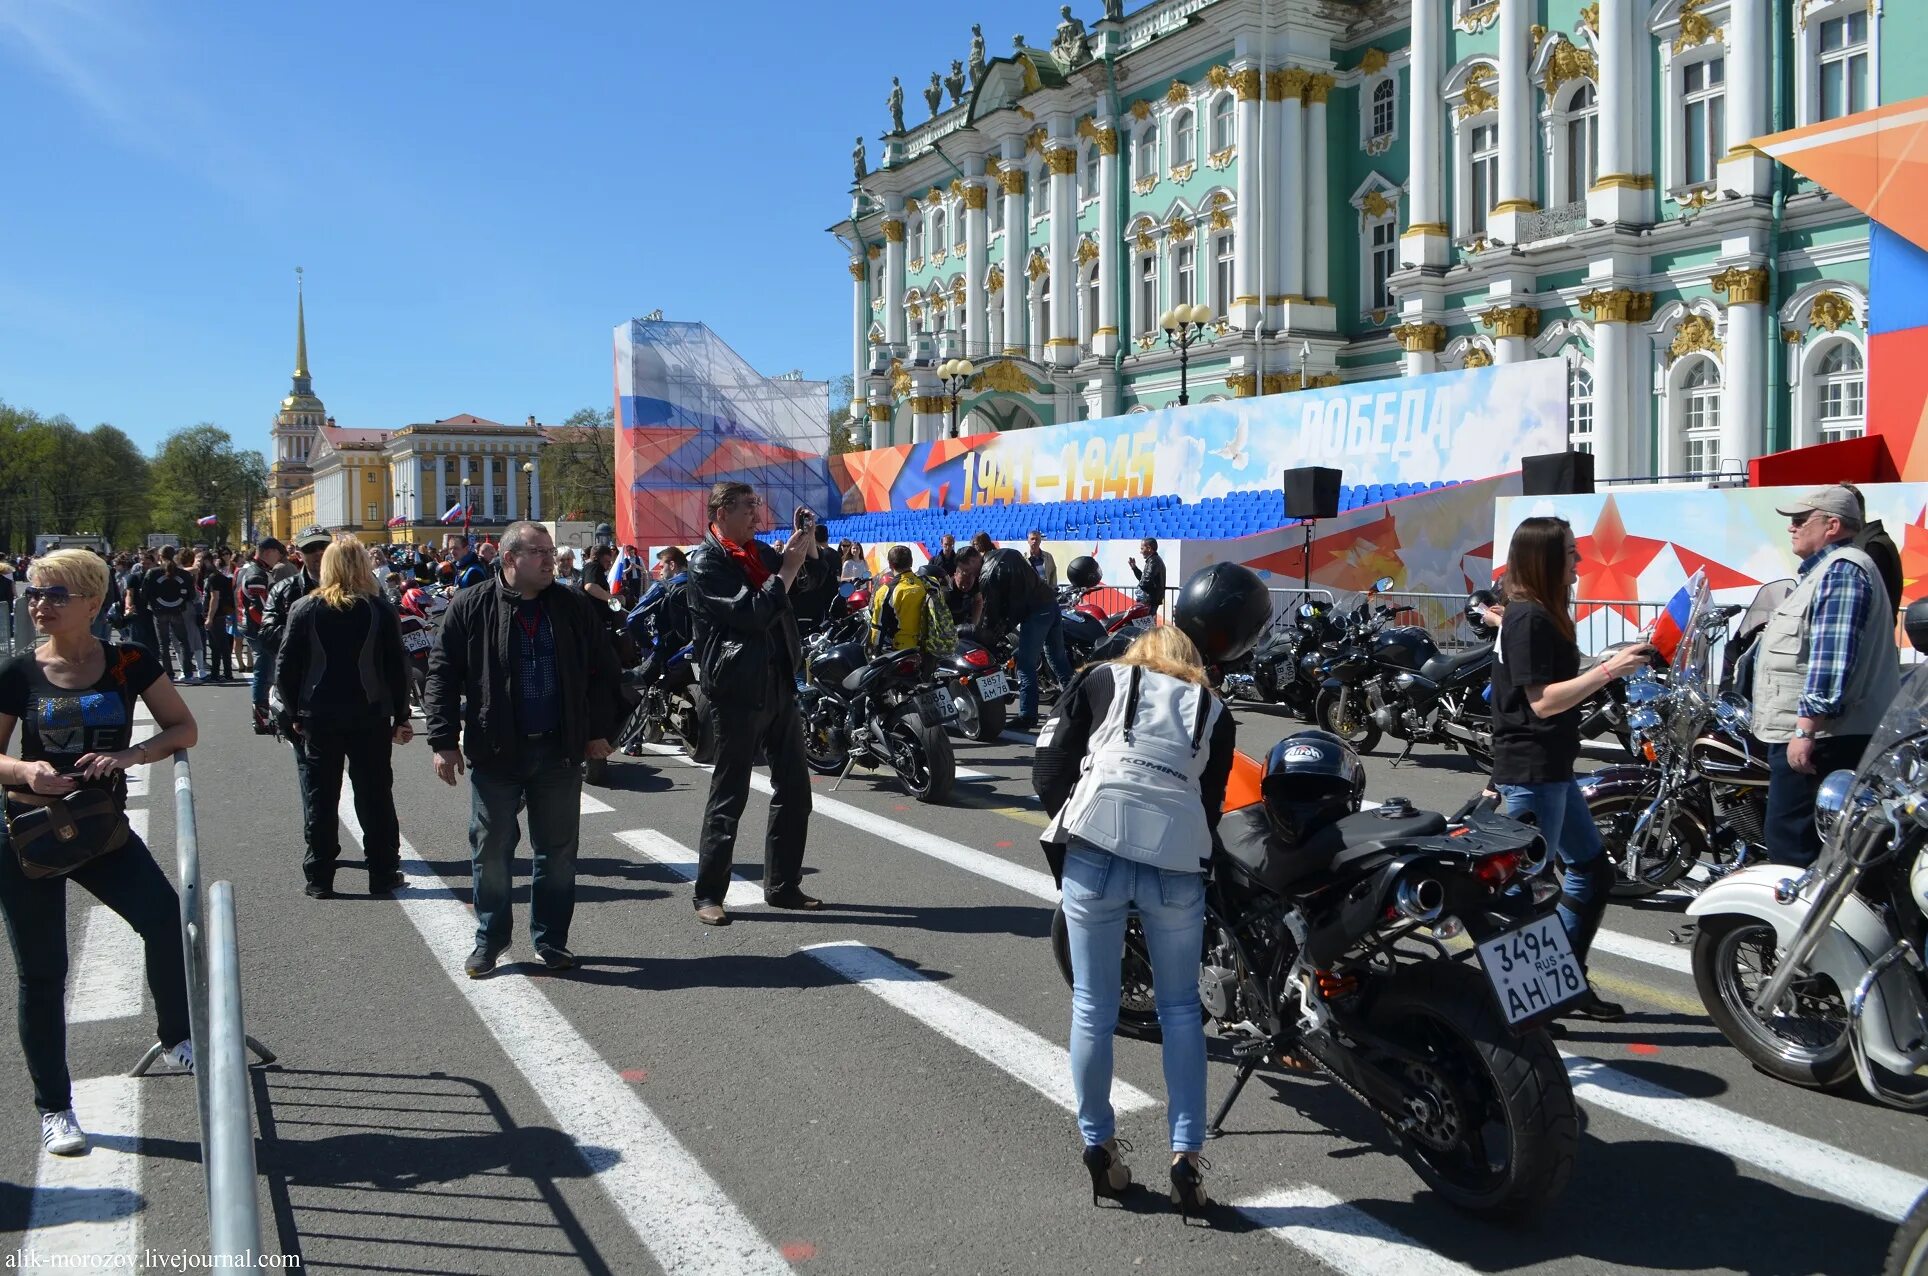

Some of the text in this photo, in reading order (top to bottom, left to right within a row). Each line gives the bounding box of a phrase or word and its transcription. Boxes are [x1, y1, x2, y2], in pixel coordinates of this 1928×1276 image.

[1299, 386, 1450, 462] ПОБЕДА
[981, 674, 1002, 688] 3857
[997, 685, 1008, 696] 78
[940, 703, 955, 716] 78
[1494, 925, 1558, 973] 3494
[1534, 955, 1557, 973] RUS
[1546, 963, 1579, 998] 78
